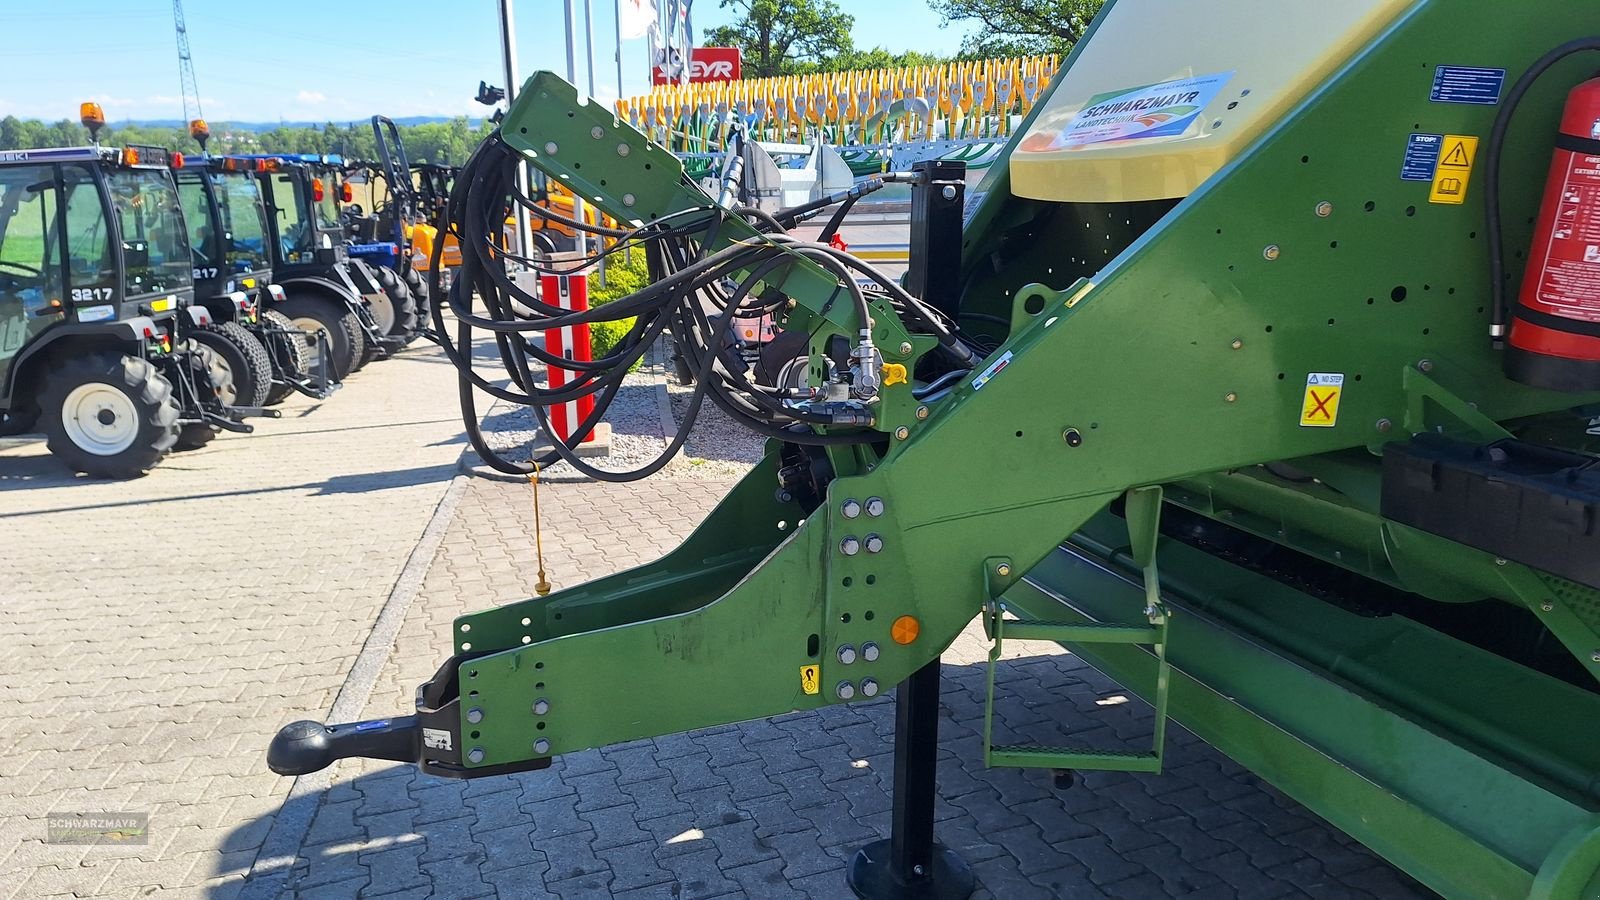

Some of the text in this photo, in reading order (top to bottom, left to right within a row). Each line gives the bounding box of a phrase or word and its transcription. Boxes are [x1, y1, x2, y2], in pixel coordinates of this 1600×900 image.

[1082, 91, 1200, 118] SCHWARZMAYR
[1074, 114, 1136, 129] LANDTECHNIK
[1415, 135, 1437, 143] STOP!
[192, 267, 218, 279] 217
[71, 287, 113, 301] 3217
[1321, 375, 1343, 383] NO STEP
